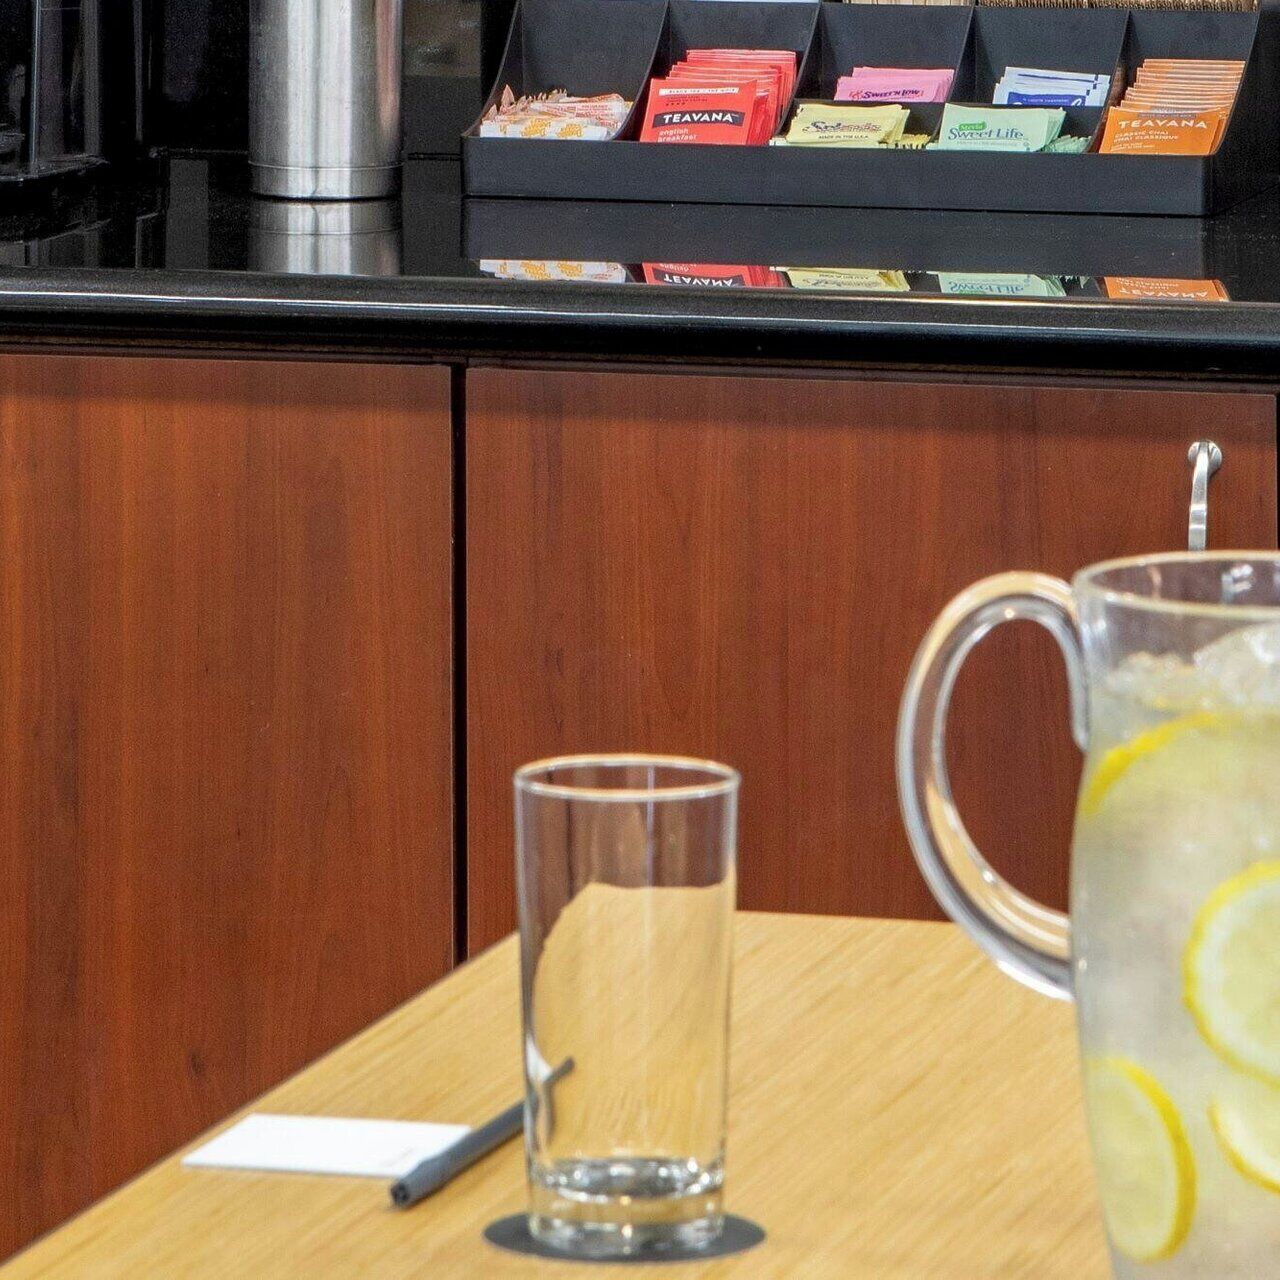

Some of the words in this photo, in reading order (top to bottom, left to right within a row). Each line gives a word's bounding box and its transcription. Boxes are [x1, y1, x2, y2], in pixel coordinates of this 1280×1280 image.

[663, 112, 734, 124] TEAVANA
[1119, 119, 1208, 129] TEAVANA
[948, 127, 993, 140] Sweet
[996, 127, 1024, 139] Life
